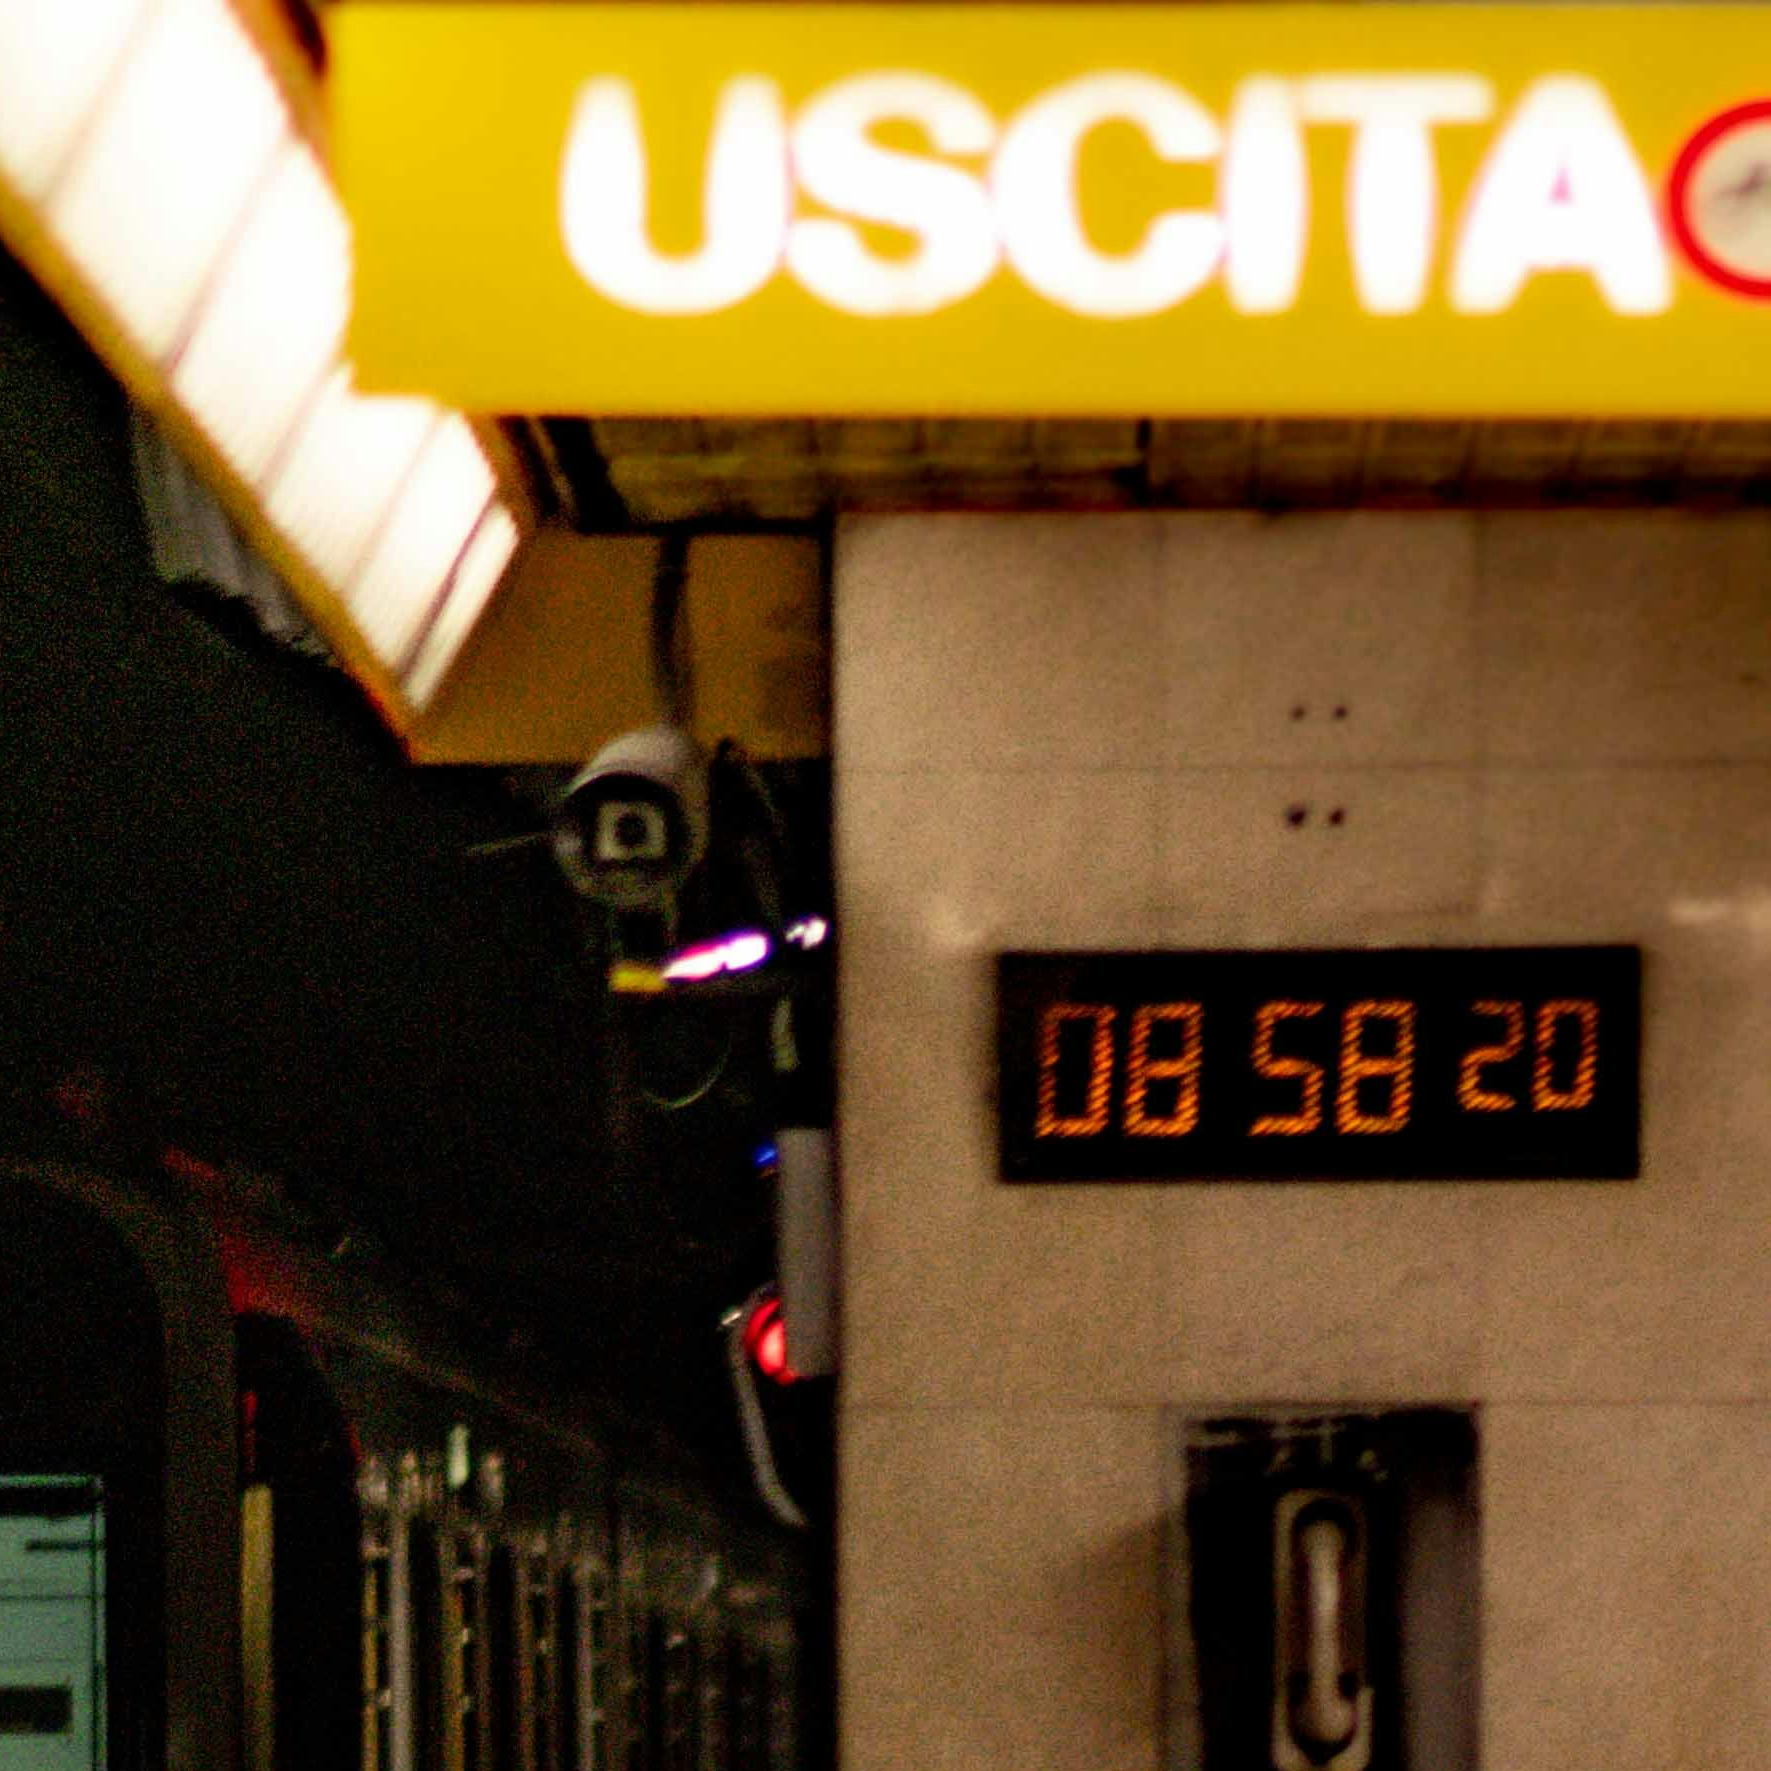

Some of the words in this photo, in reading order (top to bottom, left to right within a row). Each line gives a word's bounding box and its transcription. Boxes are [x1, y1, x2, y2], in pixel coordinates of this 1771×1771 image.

[559, 70, 1672, 318] USCITA
[1036, 1001, 1204, 1138] 08
[1248, 1000, 1418, 1137] 58
[1457, 999, 1600, 1112] 20
